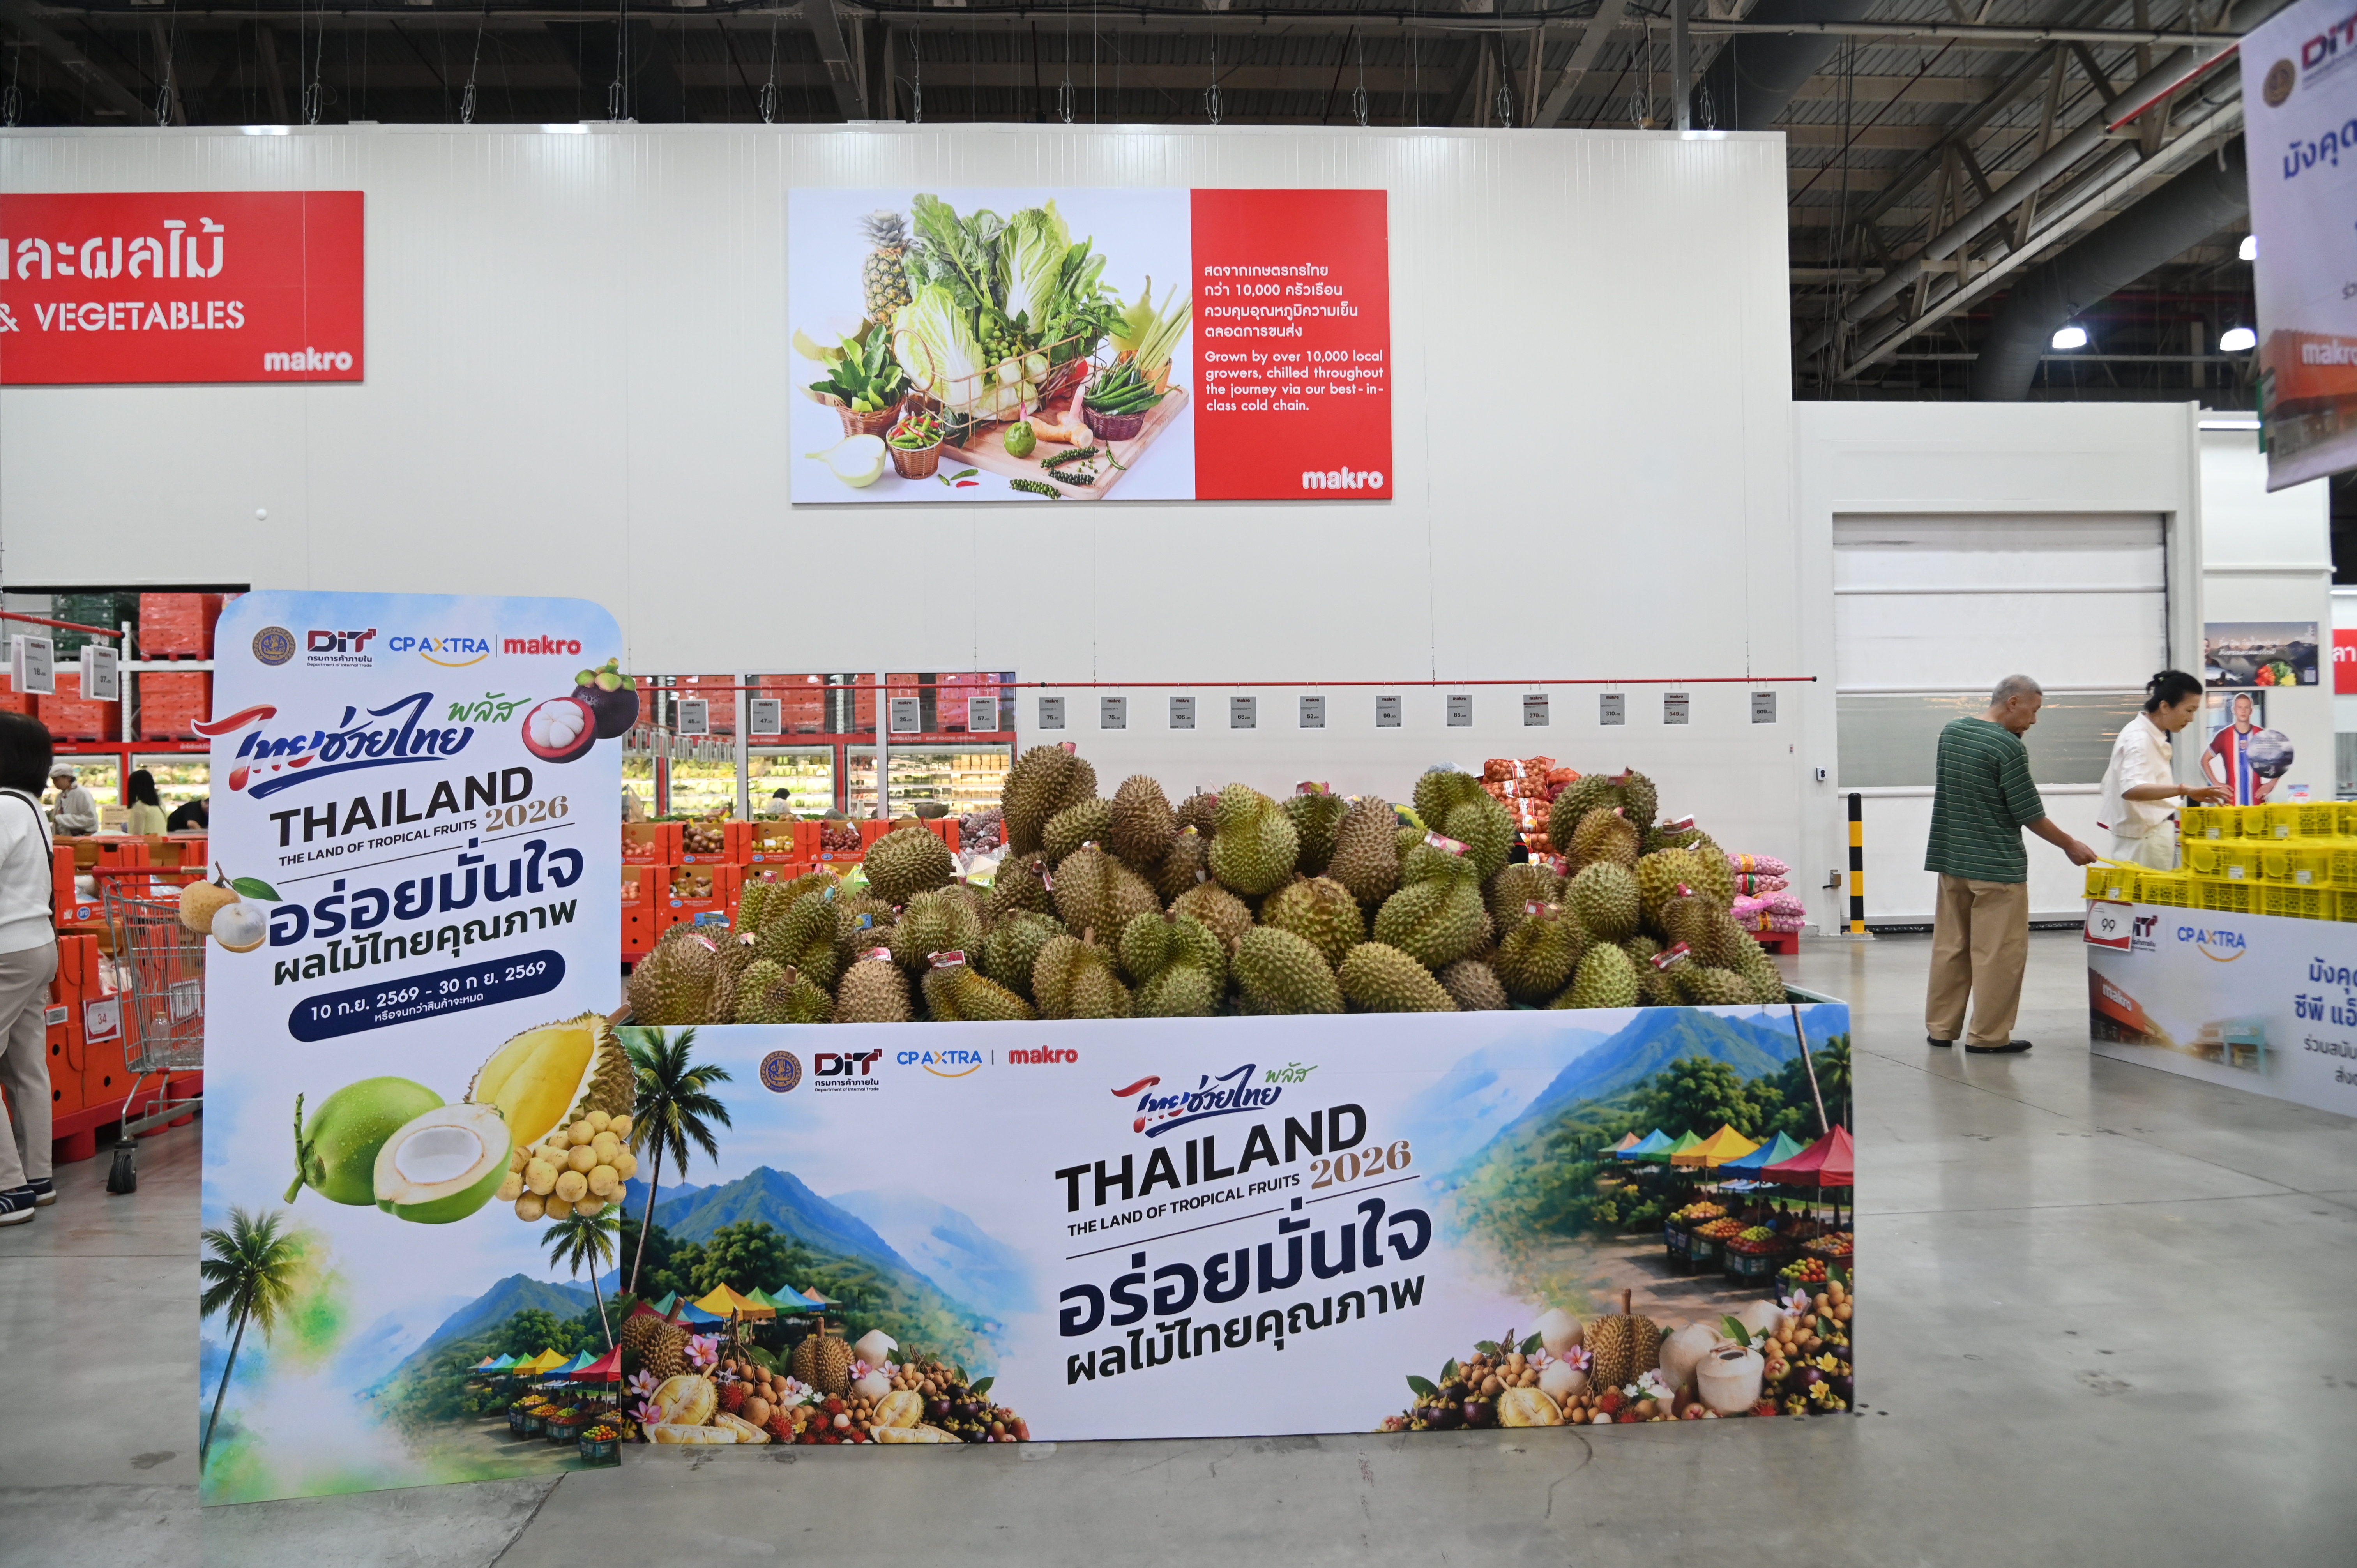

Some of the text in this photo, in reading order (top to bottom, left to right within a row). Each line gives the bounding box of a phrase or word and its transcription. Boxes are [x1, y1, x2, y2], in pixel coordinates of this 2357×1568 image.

[1204, 263, 1329, 277] สดจากเกษตรกรไทย
[1204, 281, 1343, 297] กว่า 10,000 ครัวเรือน
[34, 300, 245, 331] VEGETABLES
[1205, 301, 1359, 321] ควบคุมอุณหภูมิความเย็น
[1205, 323, 1303, 338] ตลอดการขนส่ง
[264, 346, 353, 372] makro
[1205, 349, 1383, 366] Grown by over 10,000 local
[1205, 366, 1384, 382] growers, chilled throughout
[1206, 383, 1226, 395] the
[1230, 383, 1277, 398] journey
[1281, 383, 1301, 395] via
[1305, 385, 1325, 395] our
[1206, 399, 1309, 411] class cold chain.
[1302, 466, 1385, 490] makro
[389, 636, 416, 653] CP
[418, 637, 491, 654] AXTRA
[503, 634, 582, 656] makro
[307, 654, 372, 662] กรมการค้าภายใน
[448, 692, 532, 724] พลัส
[191, 692, 474, 795] ไทยช่วยไทย
[1820, 770, 1825, 778] 8
[270, 766, 533, 847] THAILAND
[484, 795, 569, 833] 2026
[279, 819, 477, 867] THE LAND OF TROPICAL FRUITS
[269, 837, 584, 947] อร่อยมั่นใจ
[2101, 918, 2116, 932] 99
[274, 899, 578, 986] ผลไม้ไทยคุณภาพ
[2177, 926, 2194, 942] CP
[2196, 929, 2247, 949] AXTRA
[311, 1004, 332, 1021] 10
[338, 999, 370, 1015] ก.ย.
[376, 986, 419, 1008] 2569
[439, 978, 460, 995] 30
[505, 961, 546, 981] 2569
[98, 1013, 107, 1024] 34
[375, 992, 484, 1023] หรือจนกว่าสินค้าจะหมด
[2294, 993, 2324, 1022] ซีพี
[896, 1051, 919, 1066] CP
[921, 1050, 983, 1065] AXTRA
[1009, 1044, 1078, 1065] makro
[815, 1078, 879, 1086] กรมการค้าภายใน
[1265, 1062, 1318, 1084] พลัส
[2335, 1065, 2357, 1086] ส่ง
[1111, 1063, 1282, 1134] ไทยช่วยไทย
[1055, 1103, 1367, 1213] THAILAND
[1309, 1139, 1412, 1190] 2026
[1067, 1173, 1300, 1238] THE LAND OF TROPICAL FRUITS
[1060, 1196, 1432, 1337] อร่อยมั่นใจ
[1067, 1275, 1426, 1386] ผลไม้ไทยคุณภาพ
